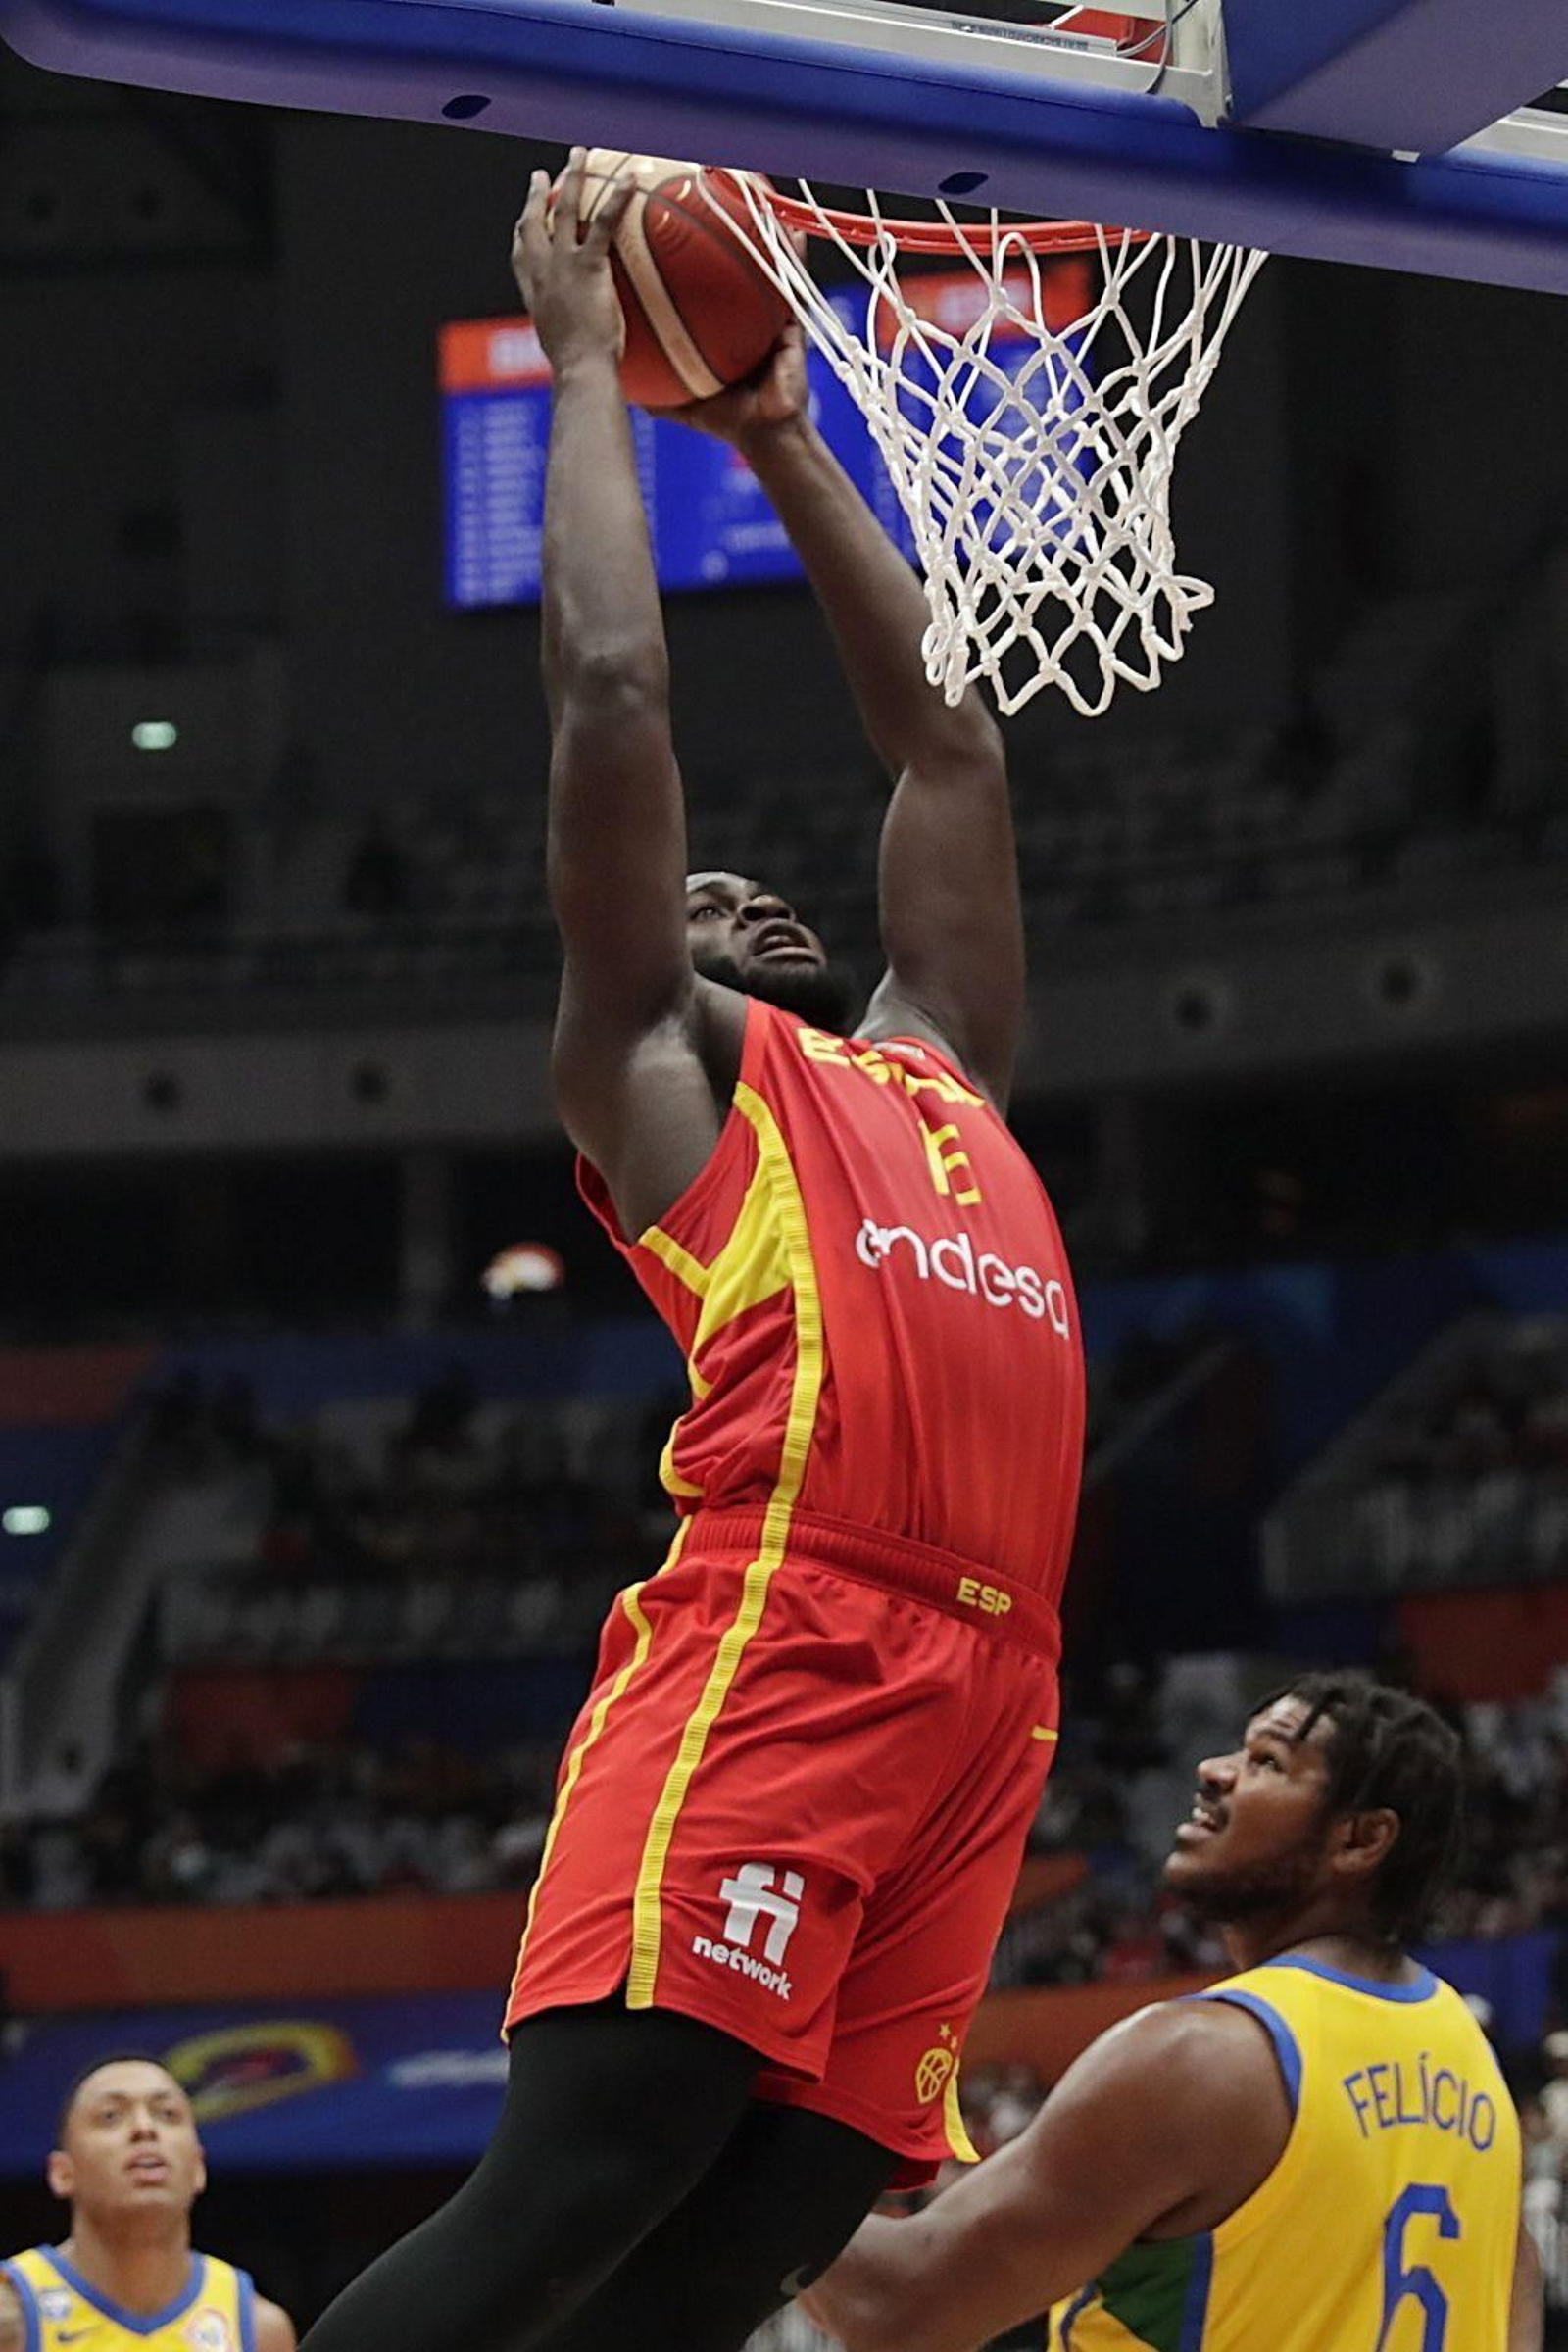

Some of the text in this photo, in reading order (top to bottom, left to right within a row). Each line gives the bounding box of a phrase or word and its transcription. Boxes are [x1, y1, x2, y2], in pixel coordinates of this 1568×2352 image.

[855, 1218, 1070, 1340] endesa
[956, 1576, 1013, 1618] ESP
[692, 1936, 794, 2000] network
[1343, 2051, 1495, 2151] FELÍCIO
[1375, 2182, 1461, 2352] 6
